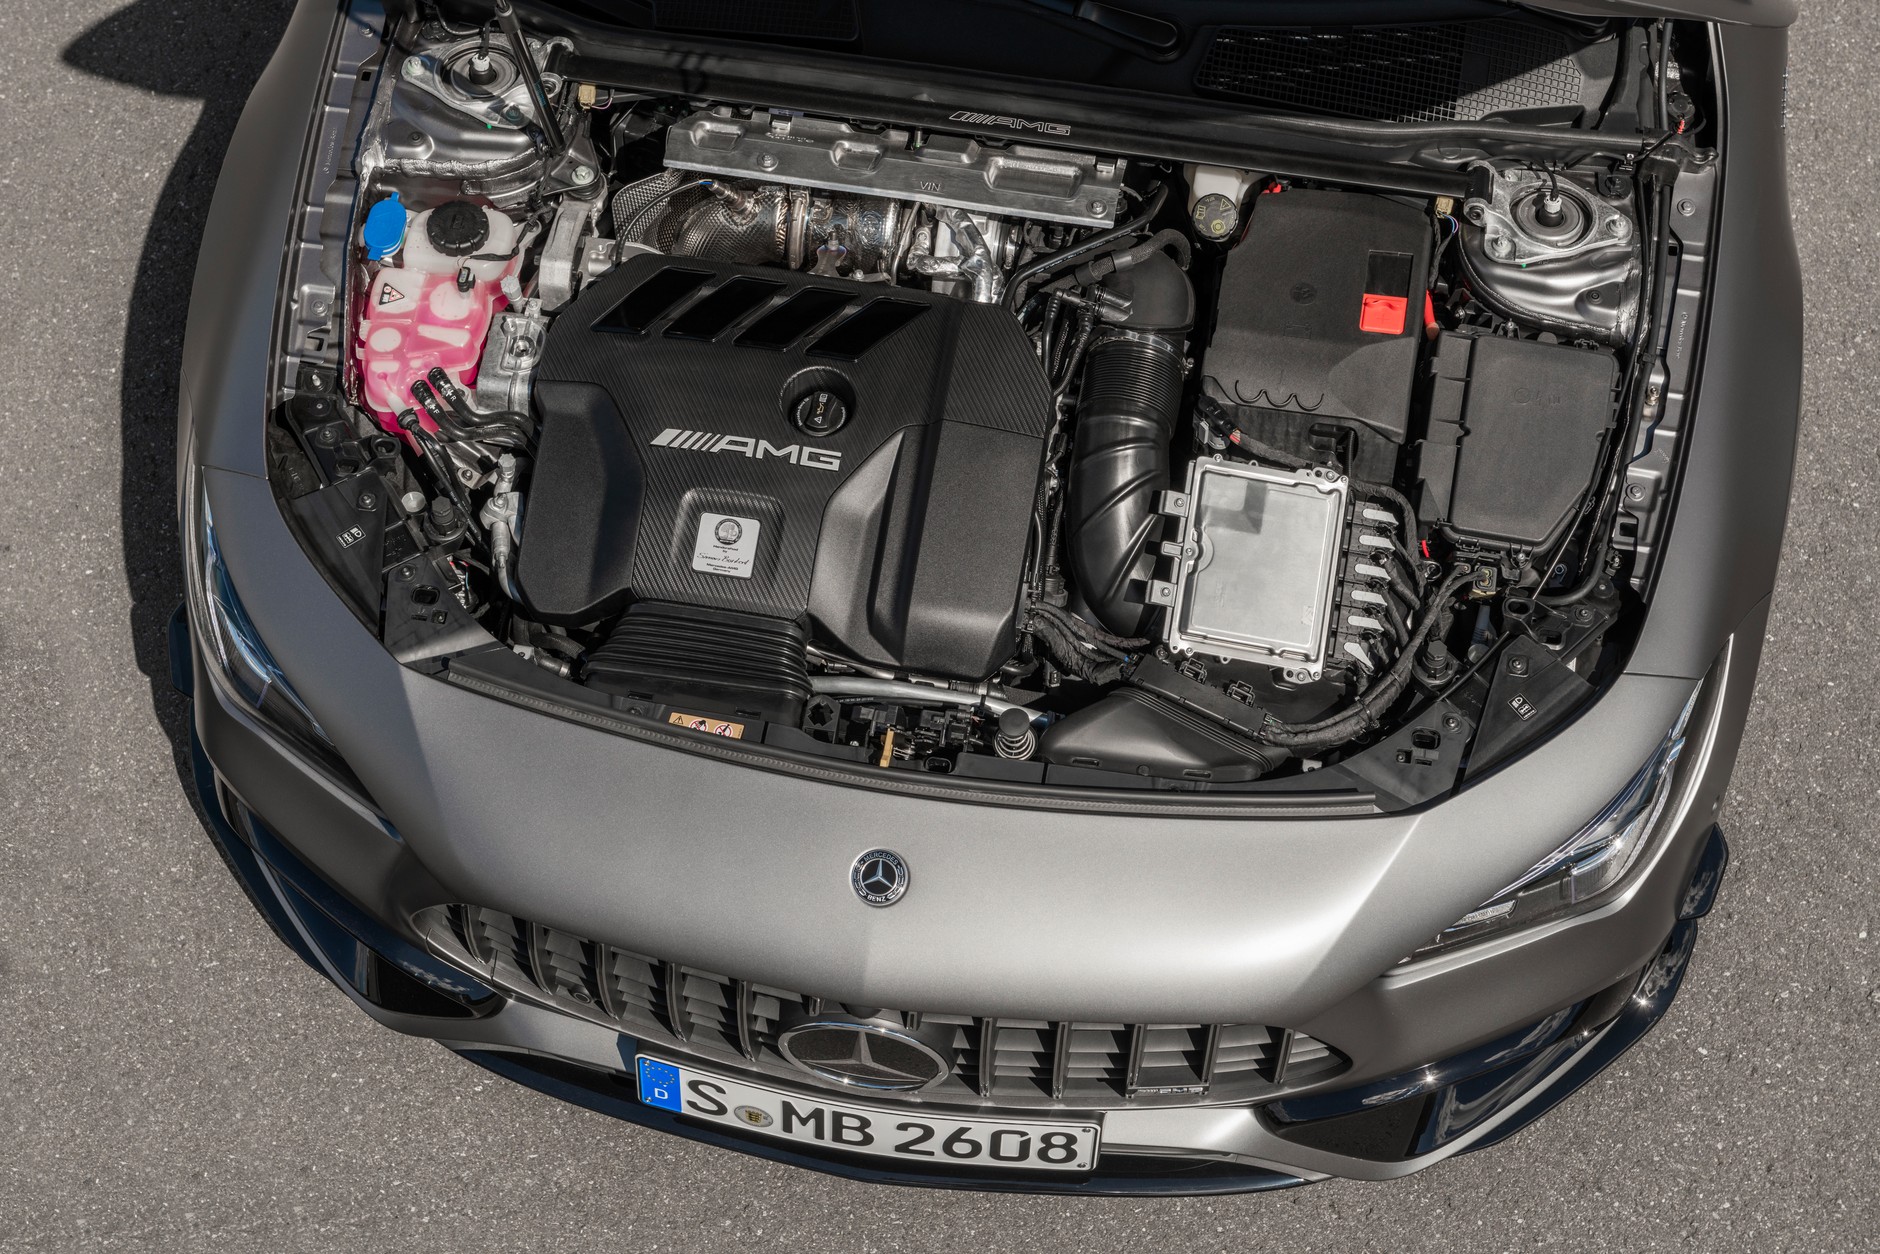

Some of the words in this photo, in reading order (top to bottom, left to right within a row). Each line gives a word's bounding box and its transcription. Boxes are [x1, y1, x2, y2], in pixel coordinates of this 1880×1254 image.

[920, 181, 941, 192] VIN
[709, 435, 842, 472] AMG
[864, 851, 899, 865] MERCEDES
[867, 894, 886, 902] BENZ
[654, 1087, 669, 1100] D
[686, 1079, 728, 1116] S
[781, 1100, 875, 1147] MB
[894, 1122, 1079, 1164] 2608
